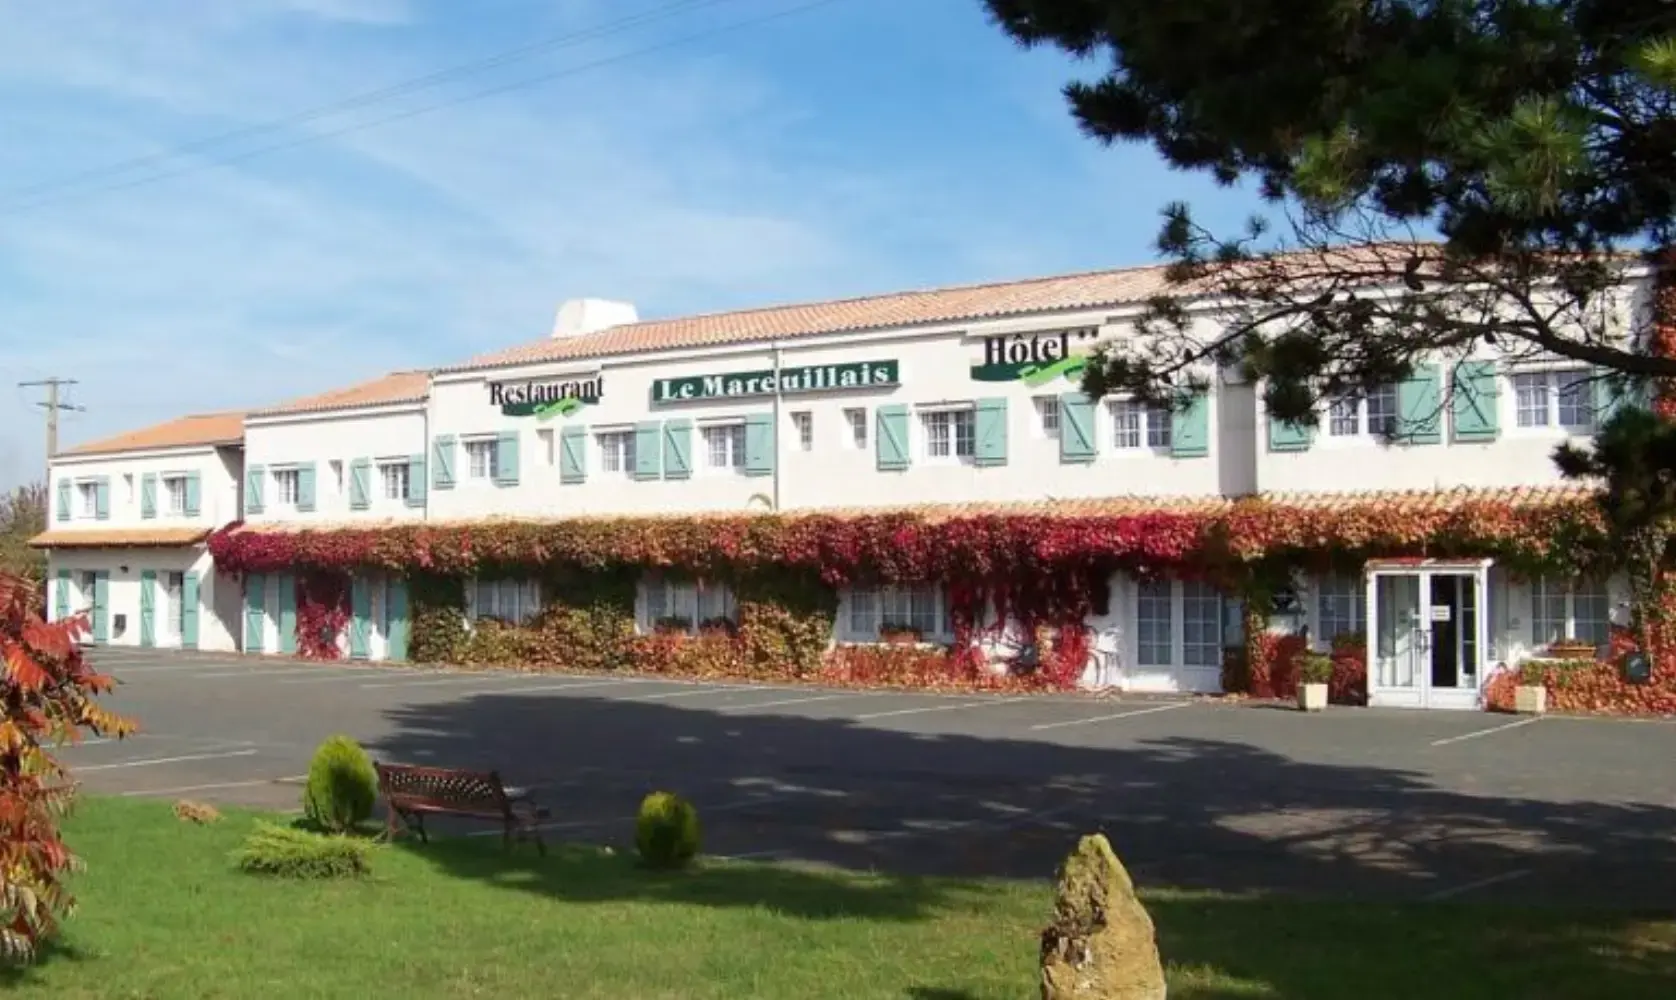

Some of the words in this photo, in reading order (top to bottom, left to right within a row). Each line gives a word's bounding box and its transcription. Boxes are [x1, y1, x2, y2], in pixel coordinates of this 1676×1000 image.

[984, 331, 1069, 364] Hôtel
[490, 374, 604, 405] Restaurant
[661, 380, 694, 399] Le
[703, 363, 889, 397] Mareuillais
